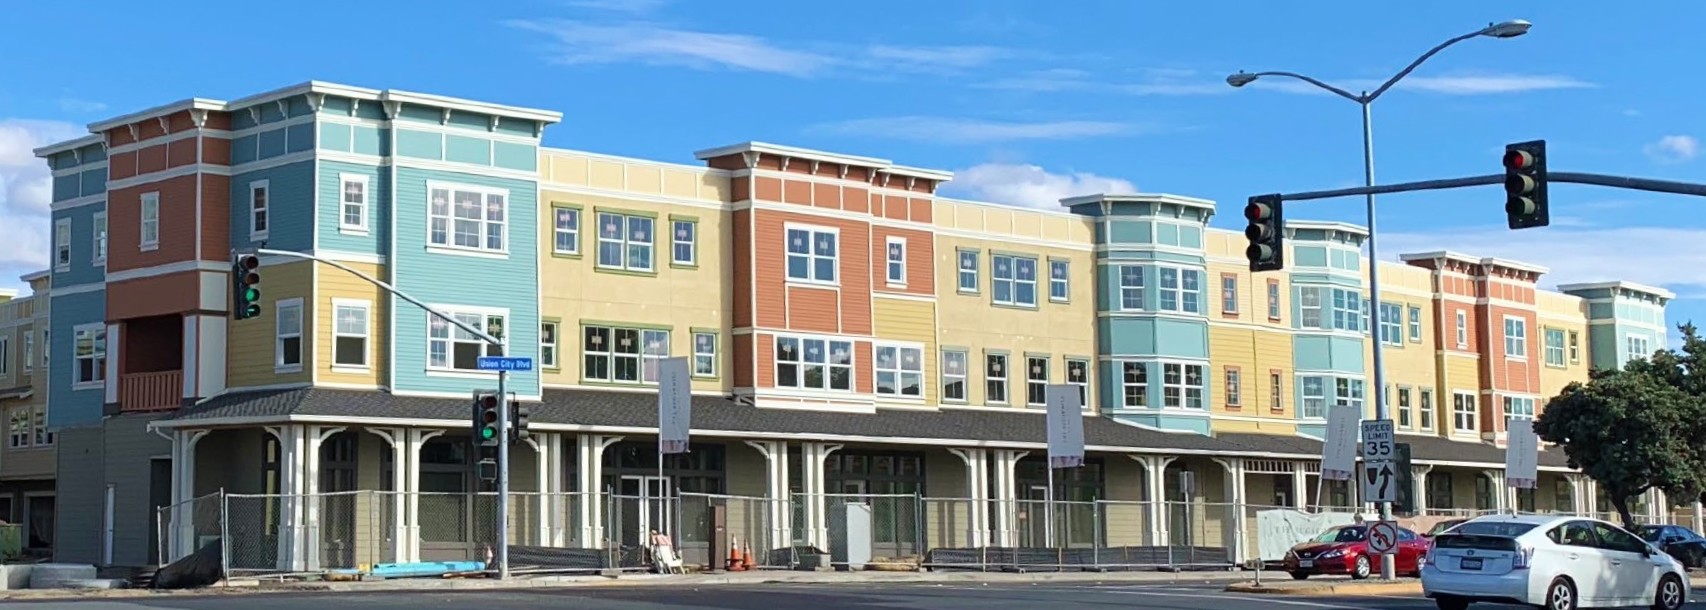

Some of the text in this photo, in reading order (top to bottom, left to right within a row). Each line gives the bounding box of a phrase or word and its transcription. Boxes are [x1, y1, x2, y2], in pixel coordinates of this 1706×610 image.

[480, 359, 530, 370] Union City Blvd
[1368, 432, 1388, 440] LIMIT
[1367, 441, 1390, 456] 35
